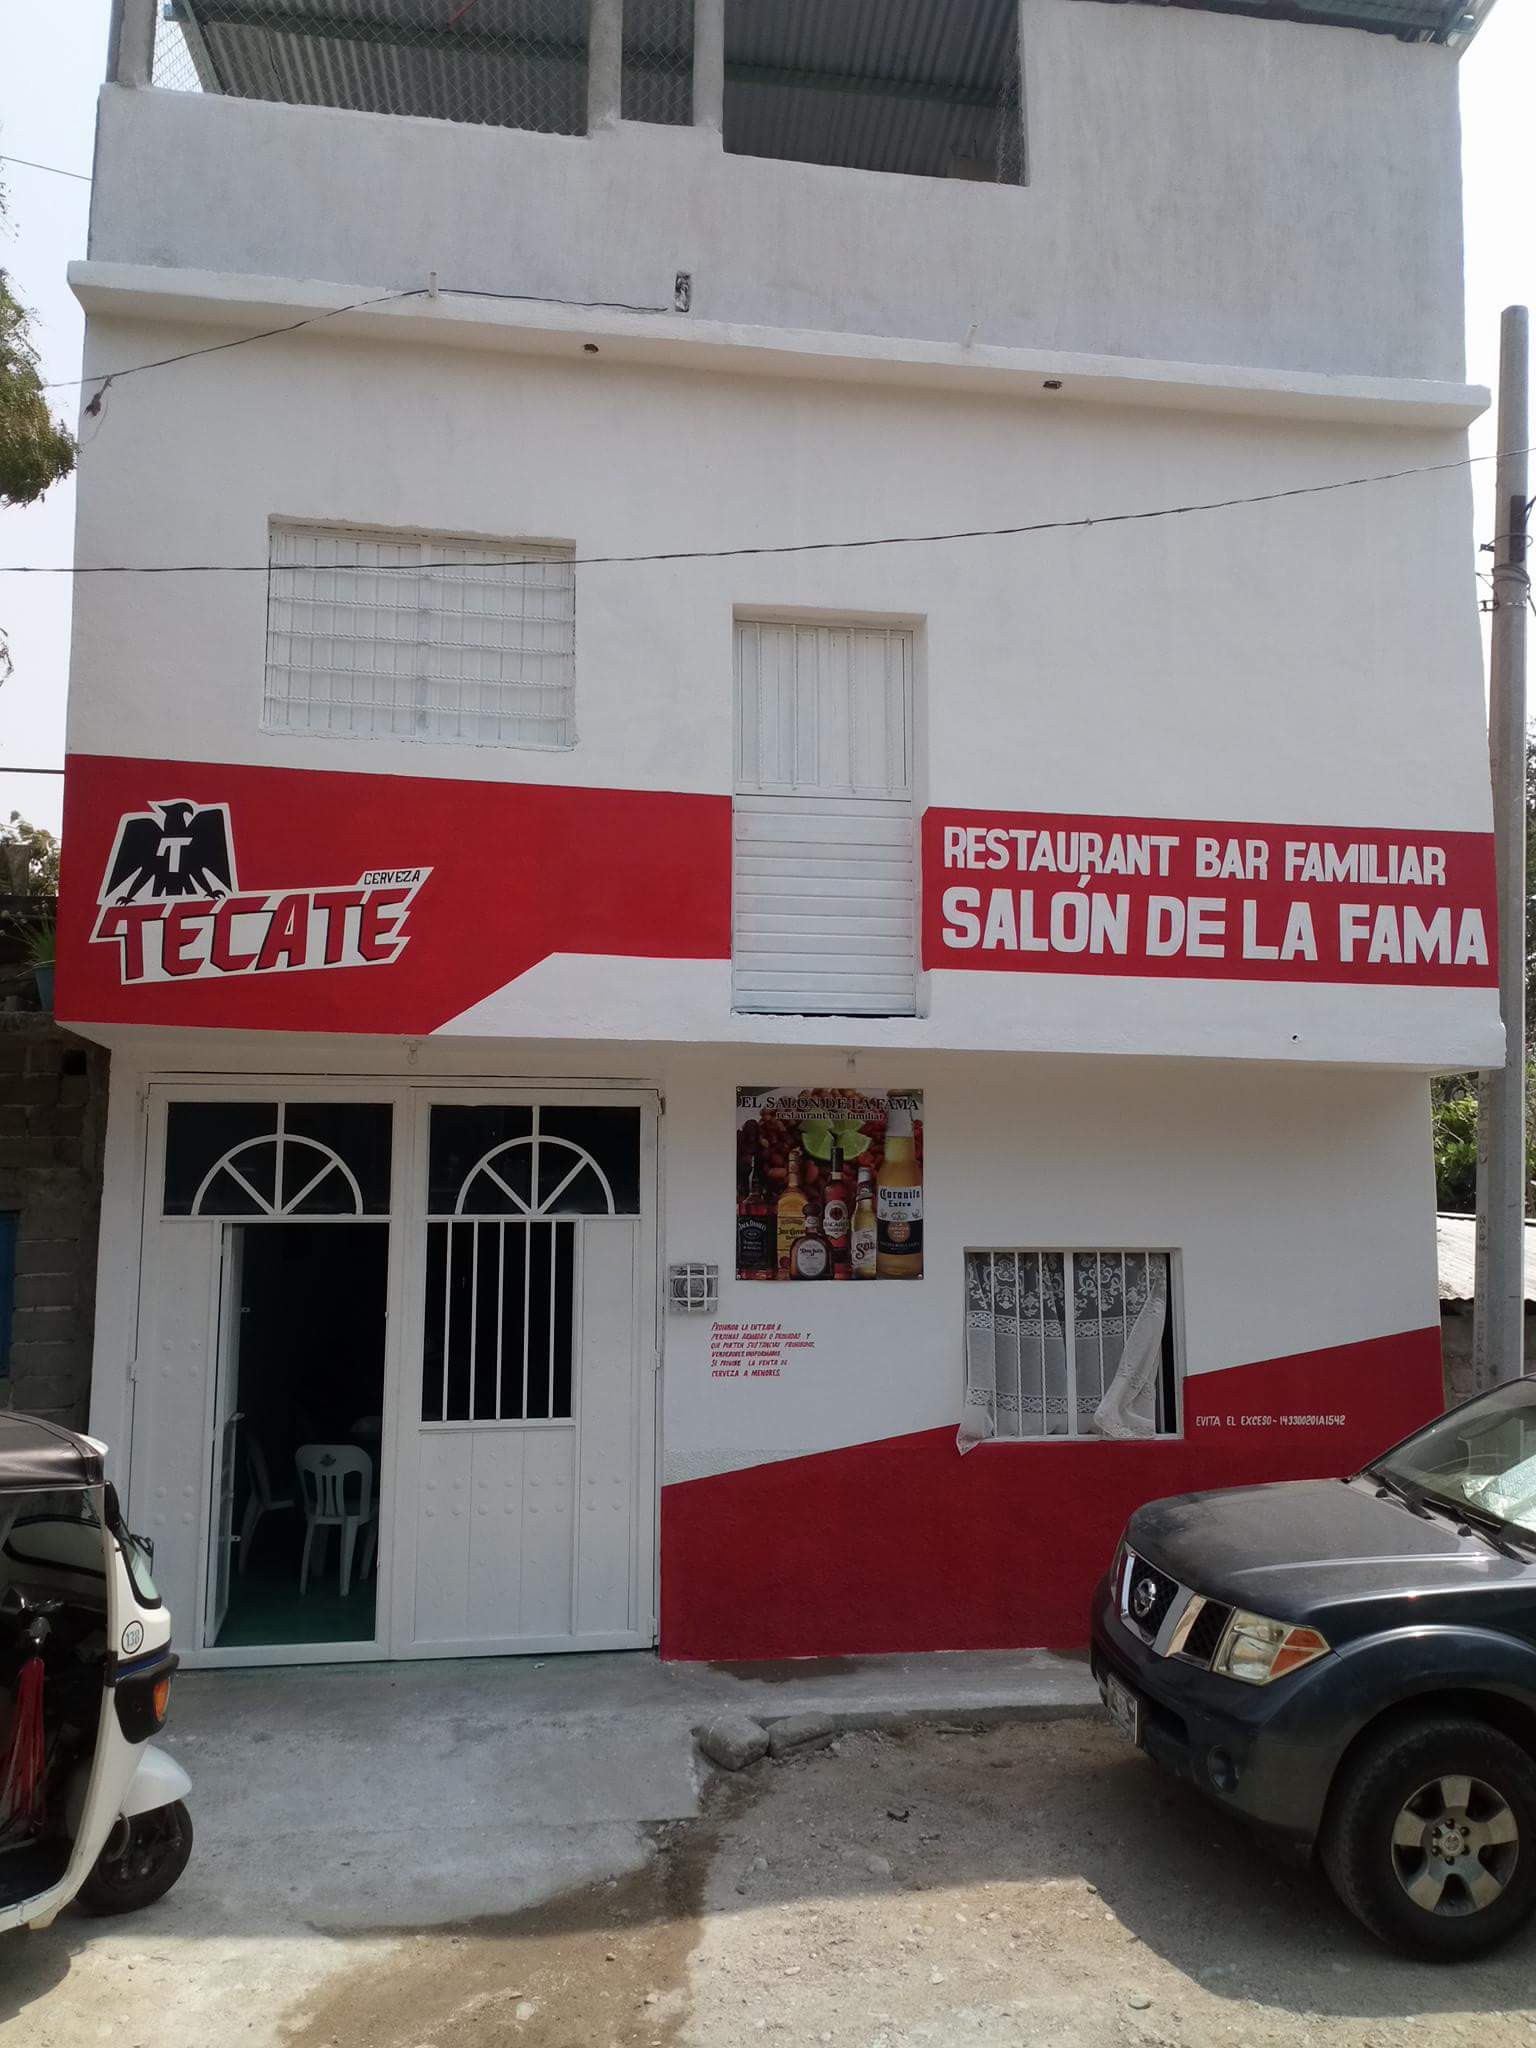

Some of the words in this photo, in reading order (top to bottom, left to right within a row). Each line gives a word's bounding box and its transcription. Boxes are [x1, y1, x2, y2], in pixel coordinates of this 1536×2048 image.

[156, 836, 193, 874] T
[943, 825, 1180, 878] RESTAURANT
[1195, 836, 1269, 881] BAR
[1284, 841, 1447, 886] FAMILIAR
[363, 868, 421, 888] CERVEZA
[942, 873, 1130, 955] SALÓN
[1146, 895, 1227, 958] DE
[1242, 899, 1318, 961] LA
[1339, 903, 1489, 966] FAMA
[98, 887, 415, 981] TECATE
[741, 1096, 762, 1108] EL
[826, 1098, 848, 1109] DE
[851, 1098, 871, 1109] LA
[876, 1098, 919, 1110] FAMA
[776, 1112, 826, 1120] restaurant
[829, 1111, 844, 1120] bar
[847, 1112, 884, 1120] familiar
[758, 1359, 778, 1367] VENTA
[711, 1370, 740, 1378] CERVEZA
[1196, 1415, 1221, 1427] EVITA
[1226, 1415, 1237, 1427] EL
[126, 1629, 140, 1647] 138
